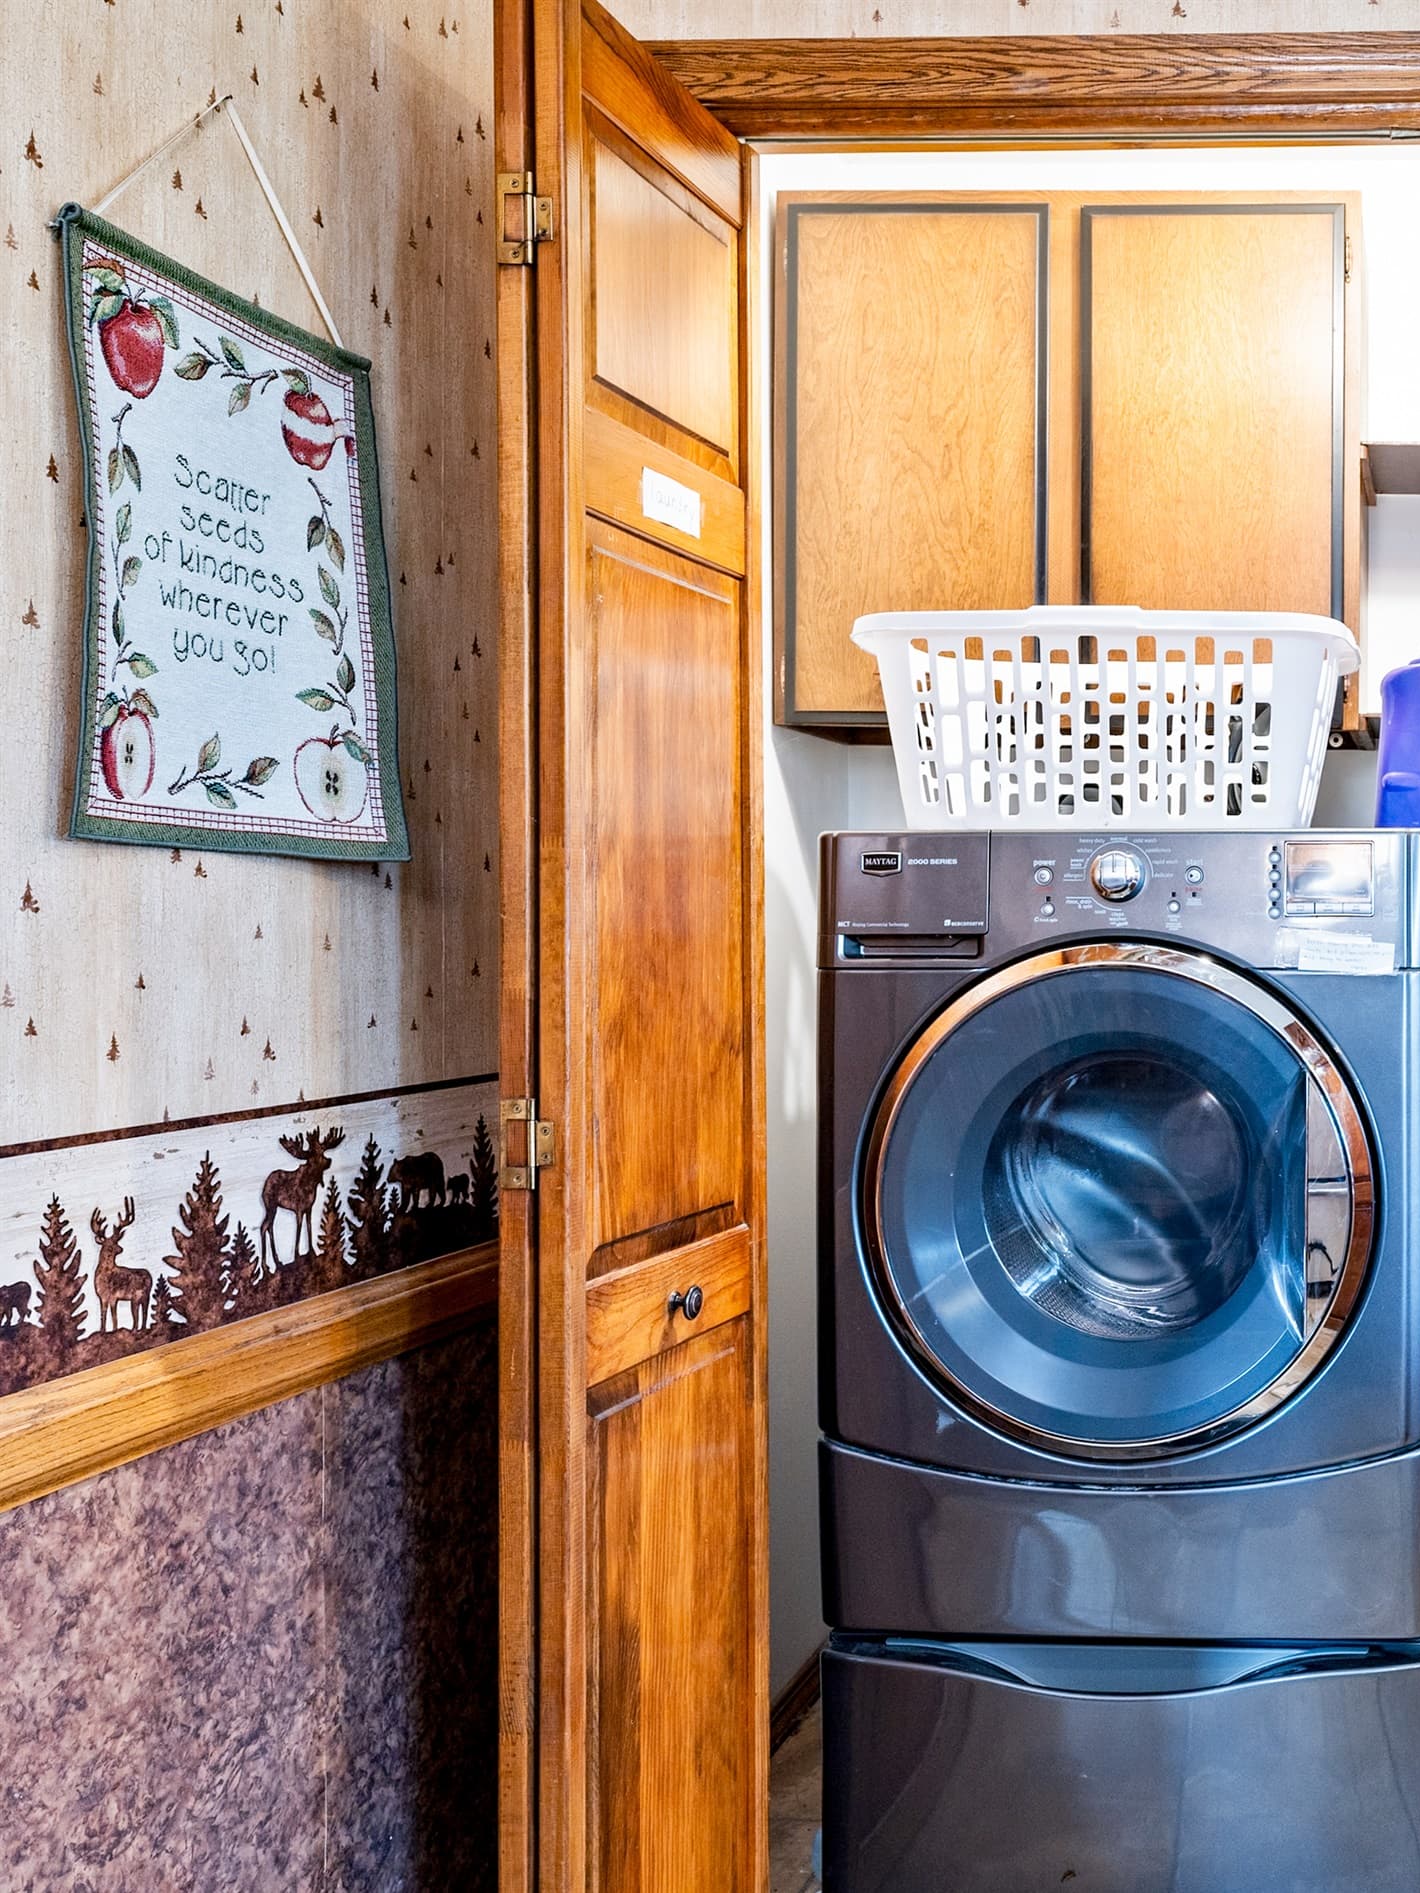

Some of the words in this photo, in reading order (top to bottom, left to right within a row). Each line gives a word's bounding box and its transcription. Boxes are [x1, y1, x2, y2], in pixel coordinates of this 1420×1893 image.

[174, 454, 271, 515] Scatter
[180, 504, 265, 554] seeds
[144, 530, 174, 563] of
[180, 540, 304, 603] kindness
[160, 579, 289, 636] wherever
[173, 627, 224, 662] you
[233, 640, 277, 677] go!
[865, 858, 897, 866] MAYTAG
[1033, 859, 1056, 867] power
